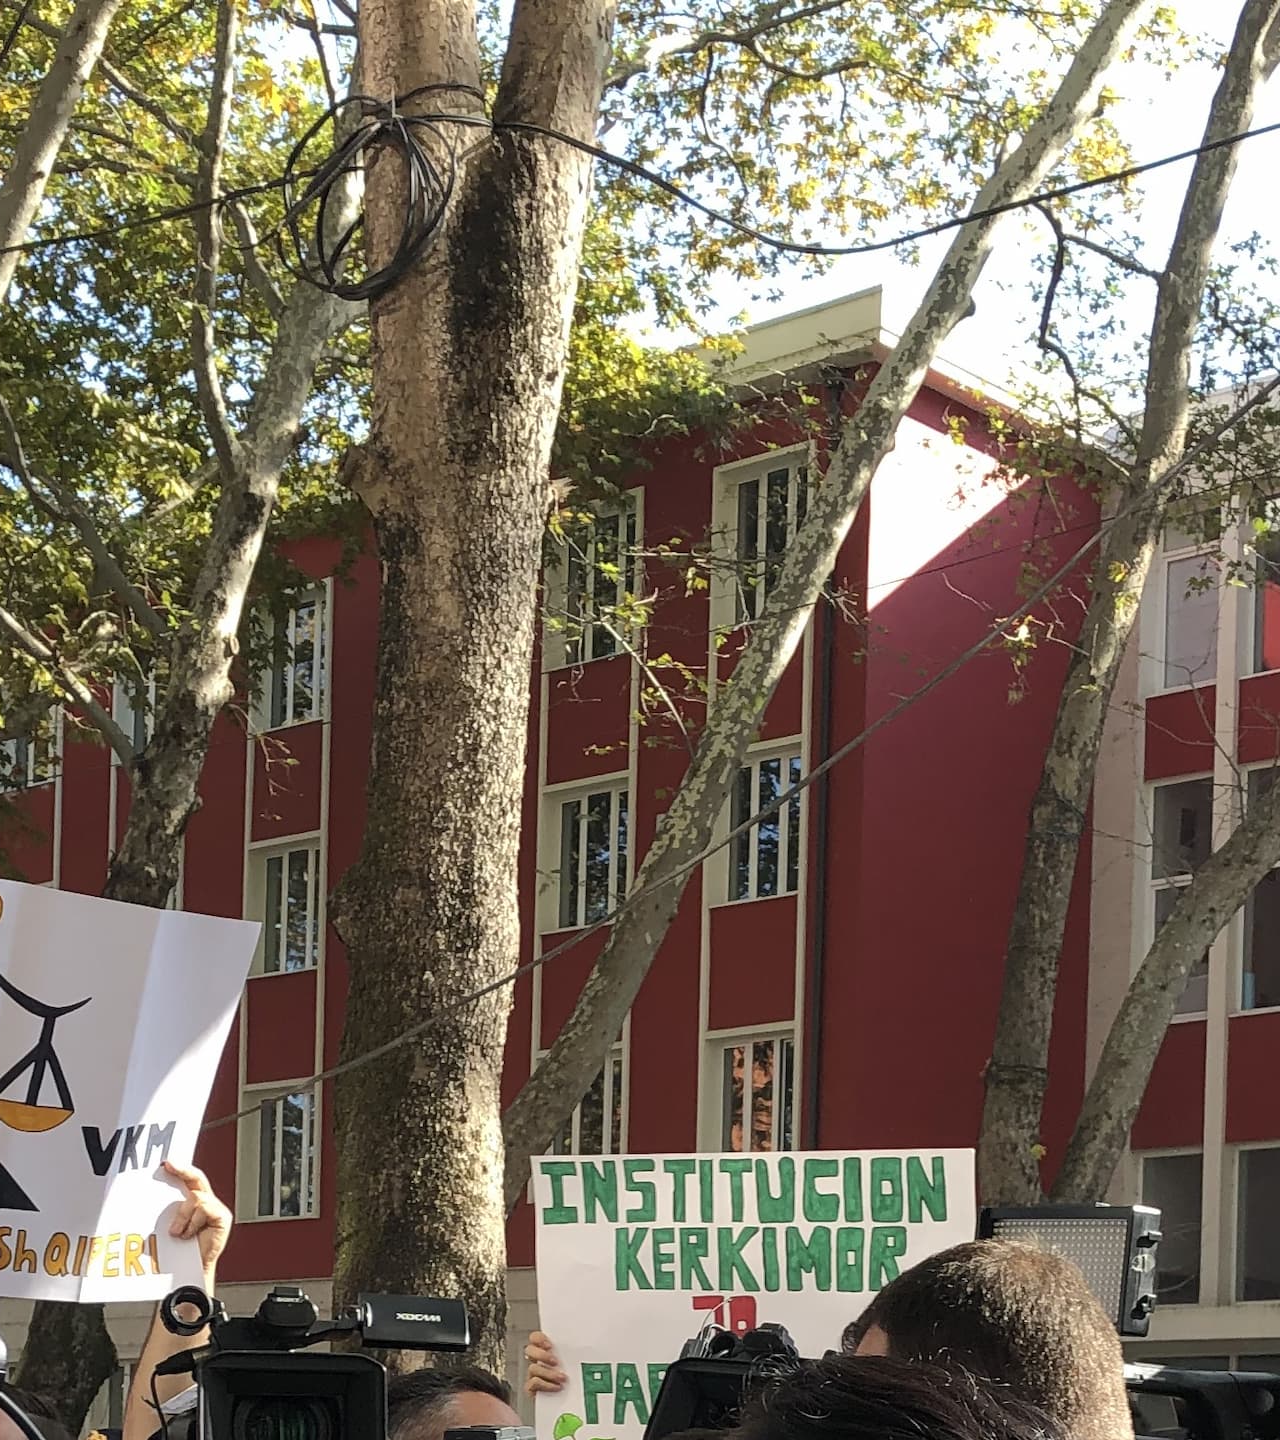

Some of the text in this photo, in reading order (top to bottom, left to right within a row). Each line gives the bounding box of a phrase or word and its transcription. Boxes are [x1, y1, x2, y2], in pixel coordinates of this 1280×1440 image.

[81, 1121, 177, 1177] VKM
[539, 1156, 948, 1225] INSTITUCION
[615, 1225, 907, 1292] KERKIMOR
